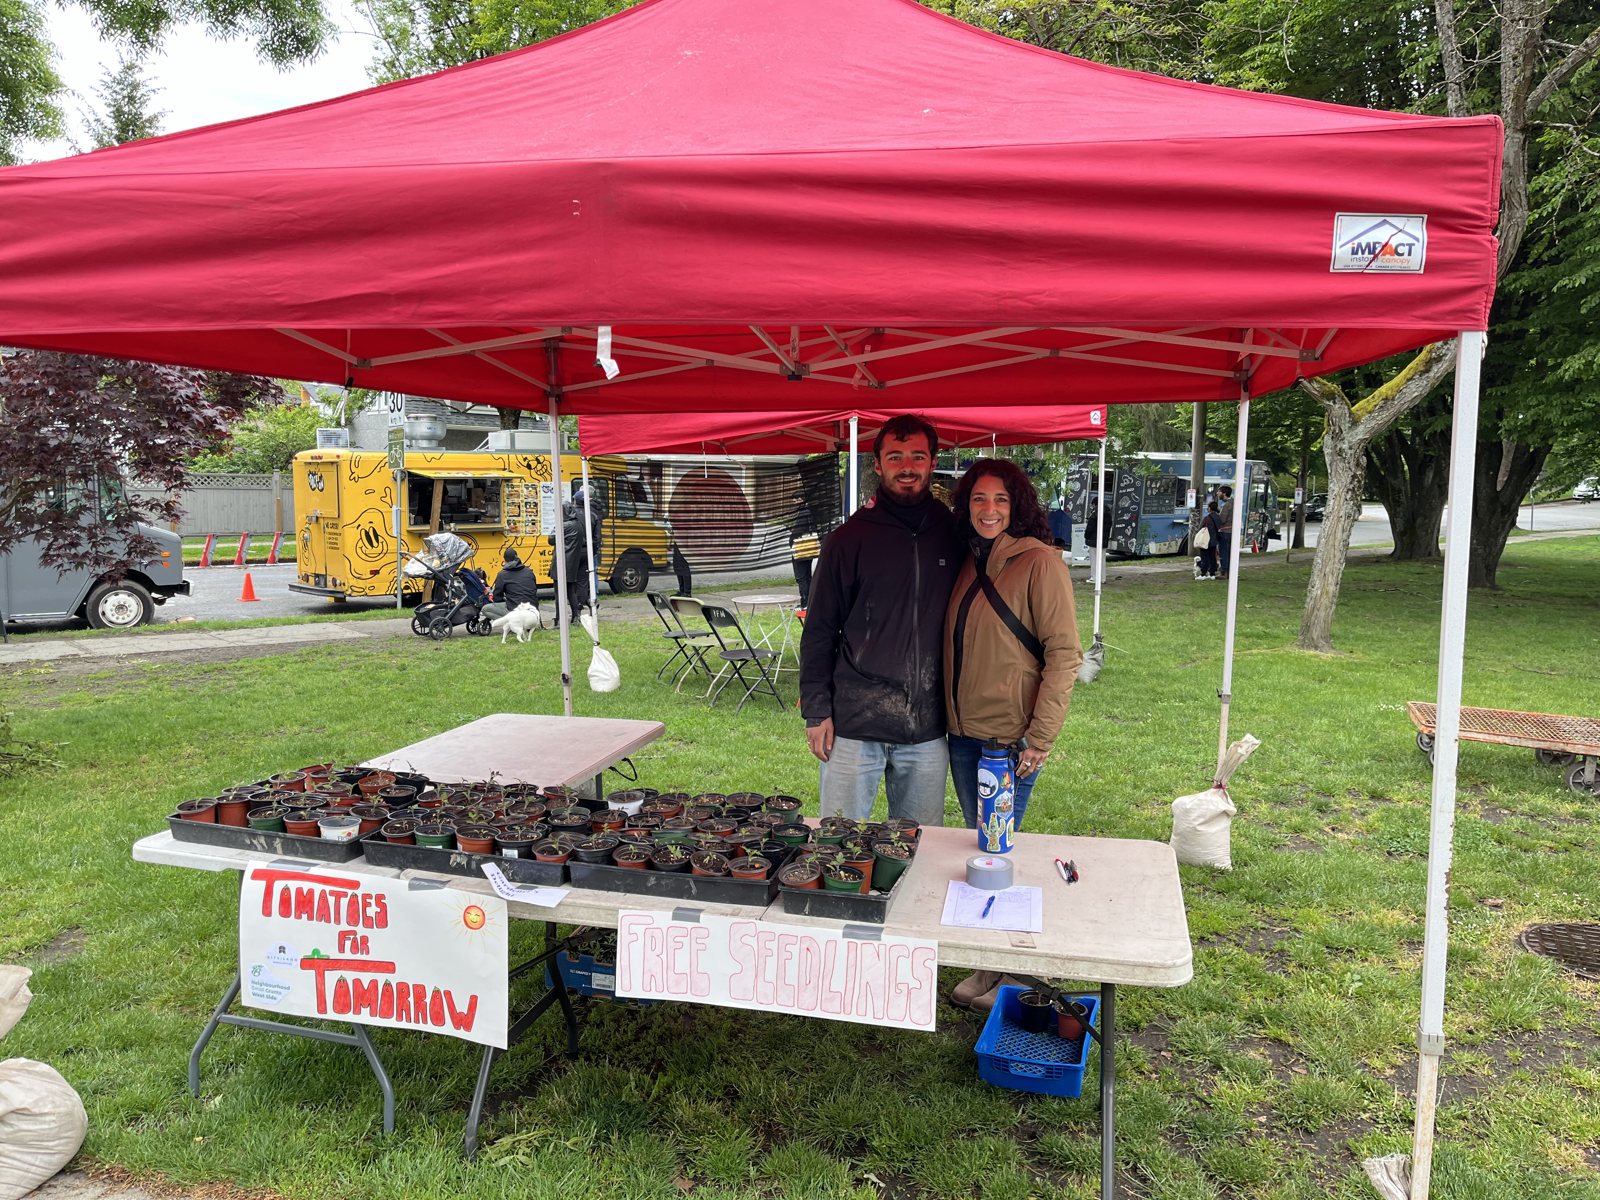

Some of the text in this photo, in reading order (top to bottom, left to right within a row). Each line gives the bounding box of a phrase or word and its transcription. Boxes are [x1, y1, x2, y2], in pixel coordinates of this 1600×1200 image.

[1351, 241, 1415, 257] iMPACT
[1381, 257, 1411, 265] canopy
[389, 392, 403, 413] 30
[250, 868, 389, 930] TOMATOES
[620, 914, 937, 1027] FREE SEEDLINGS
[251, 980, 291, 991] Neighbourhood
[265, 988, 282, 996] Grants
[300, 957, 479, 1033] TOMORROW
